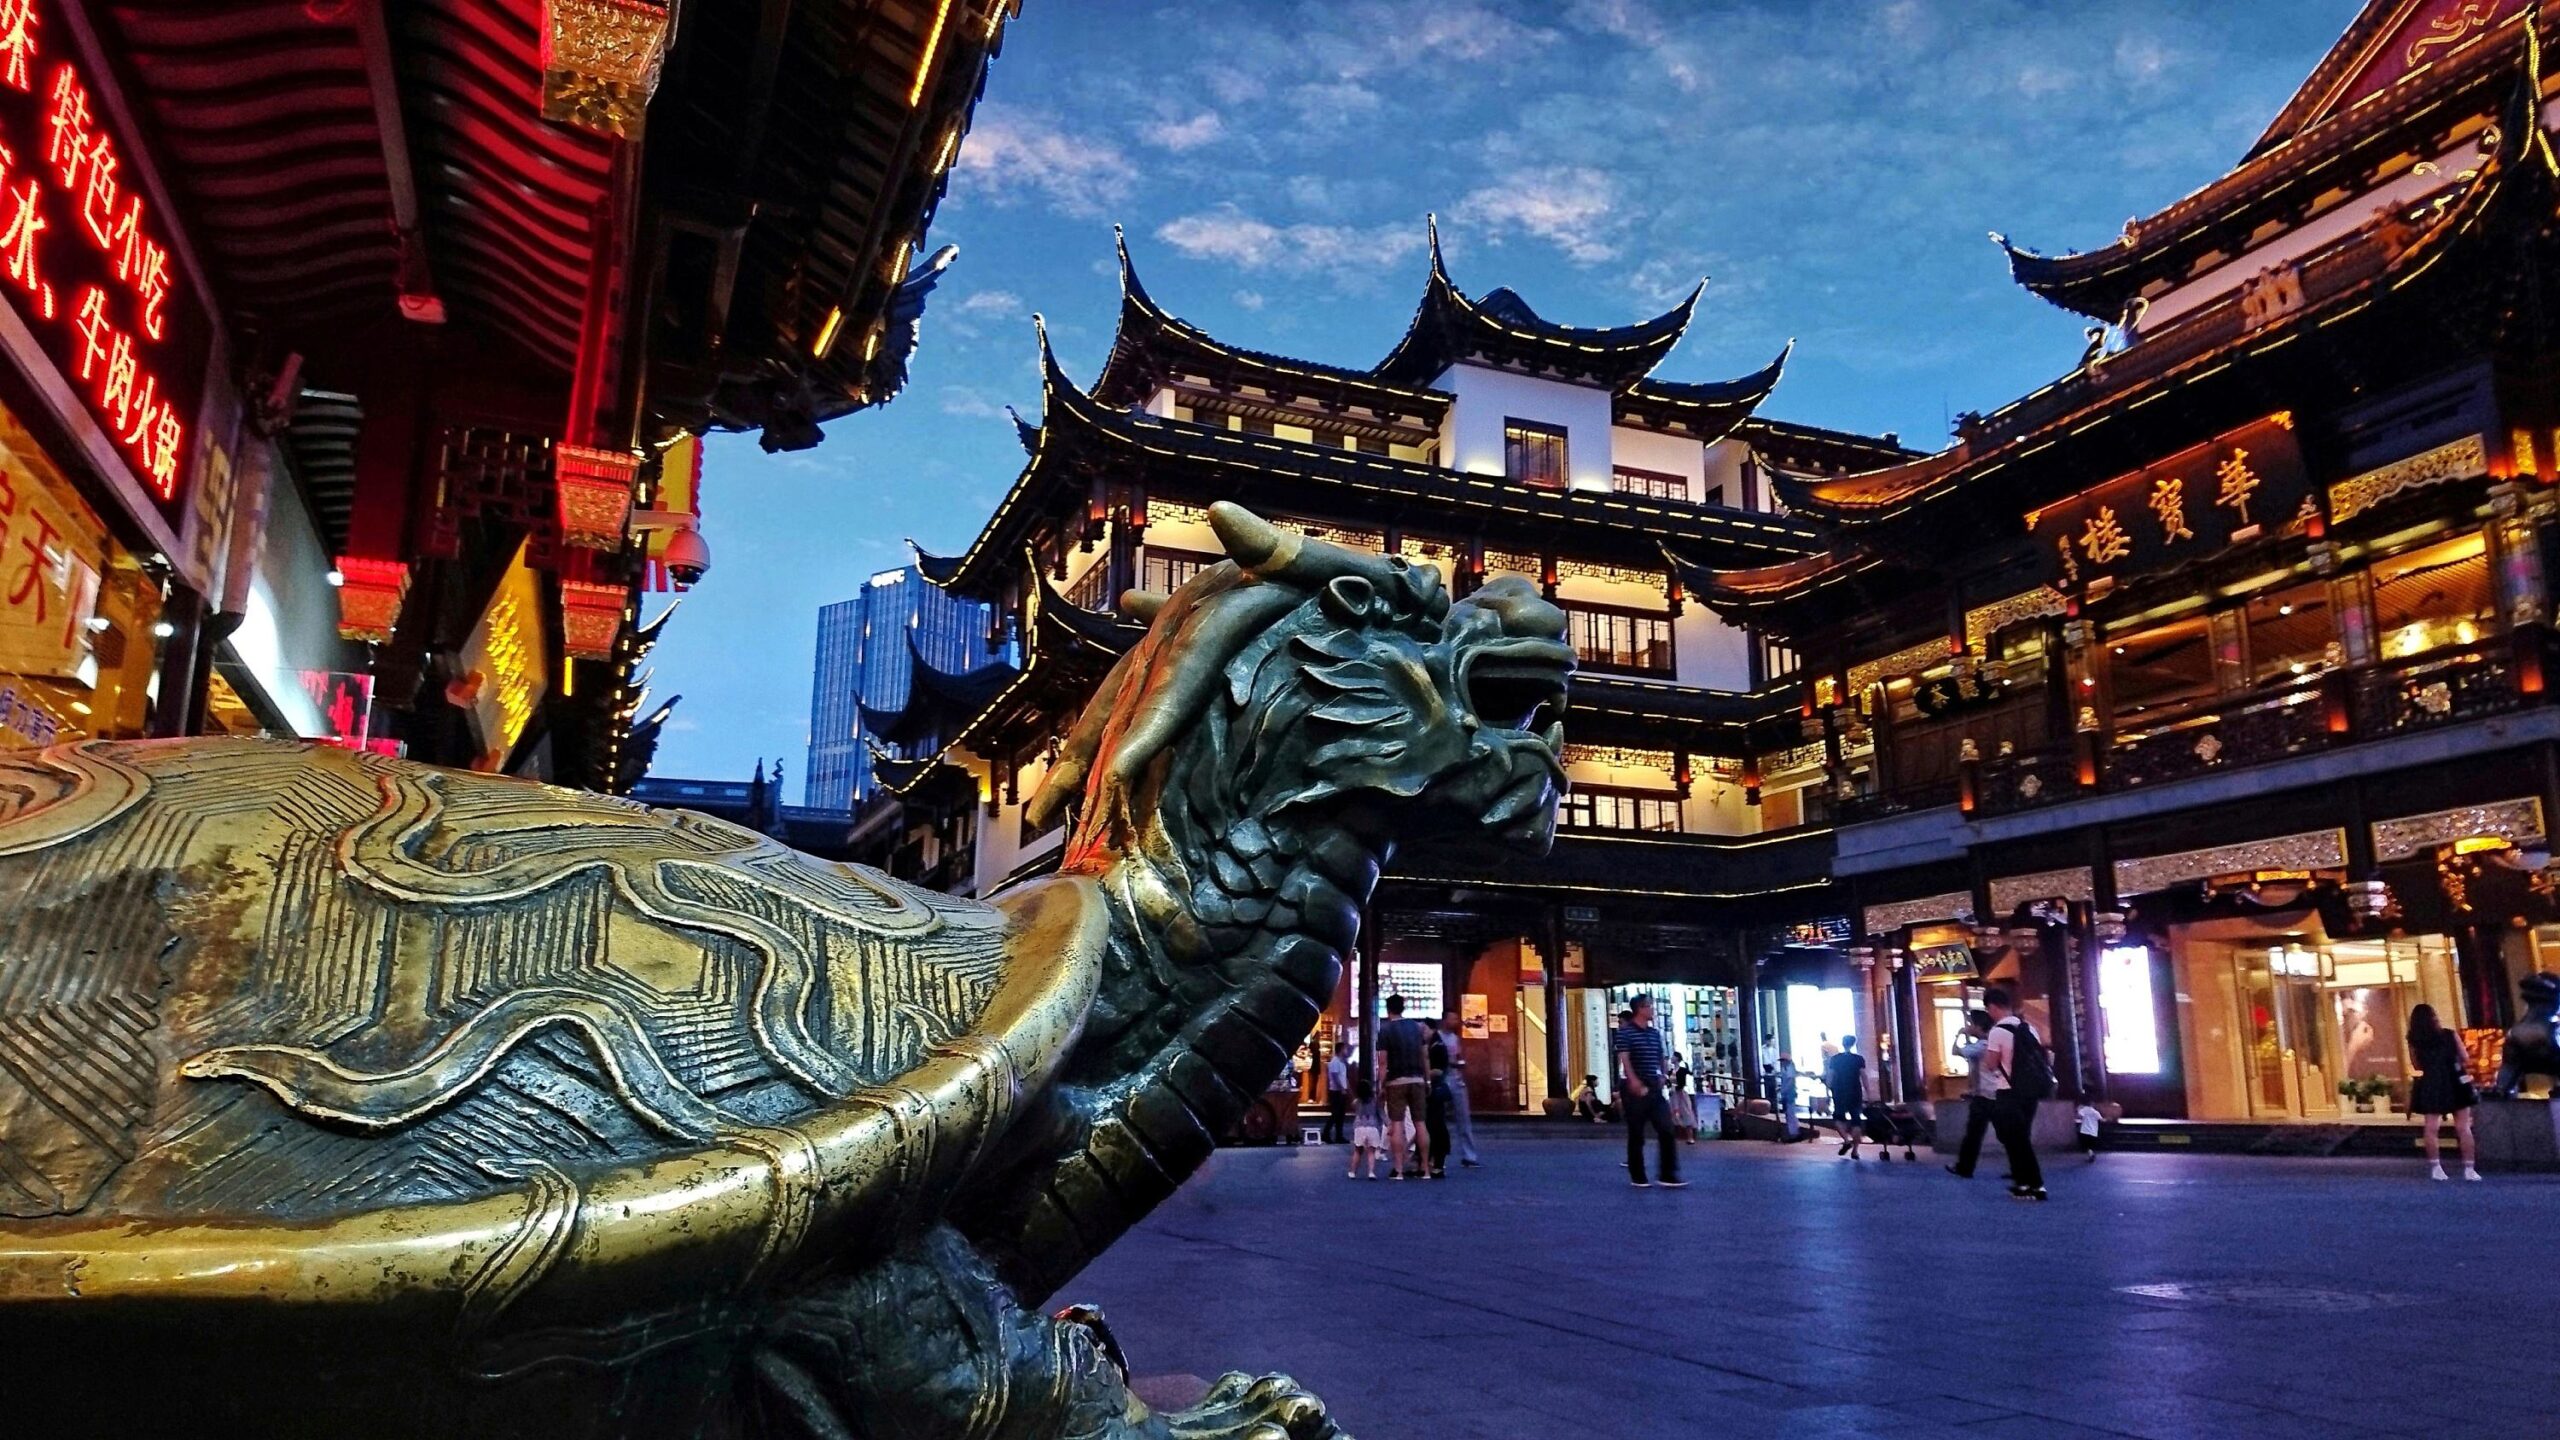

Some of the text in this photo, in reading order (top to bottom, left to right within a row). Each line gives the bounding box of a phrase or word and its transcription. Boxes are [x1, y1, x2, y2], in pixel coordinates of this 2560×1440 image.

[0, 144, 181, 500] 水、牛肉火锅
